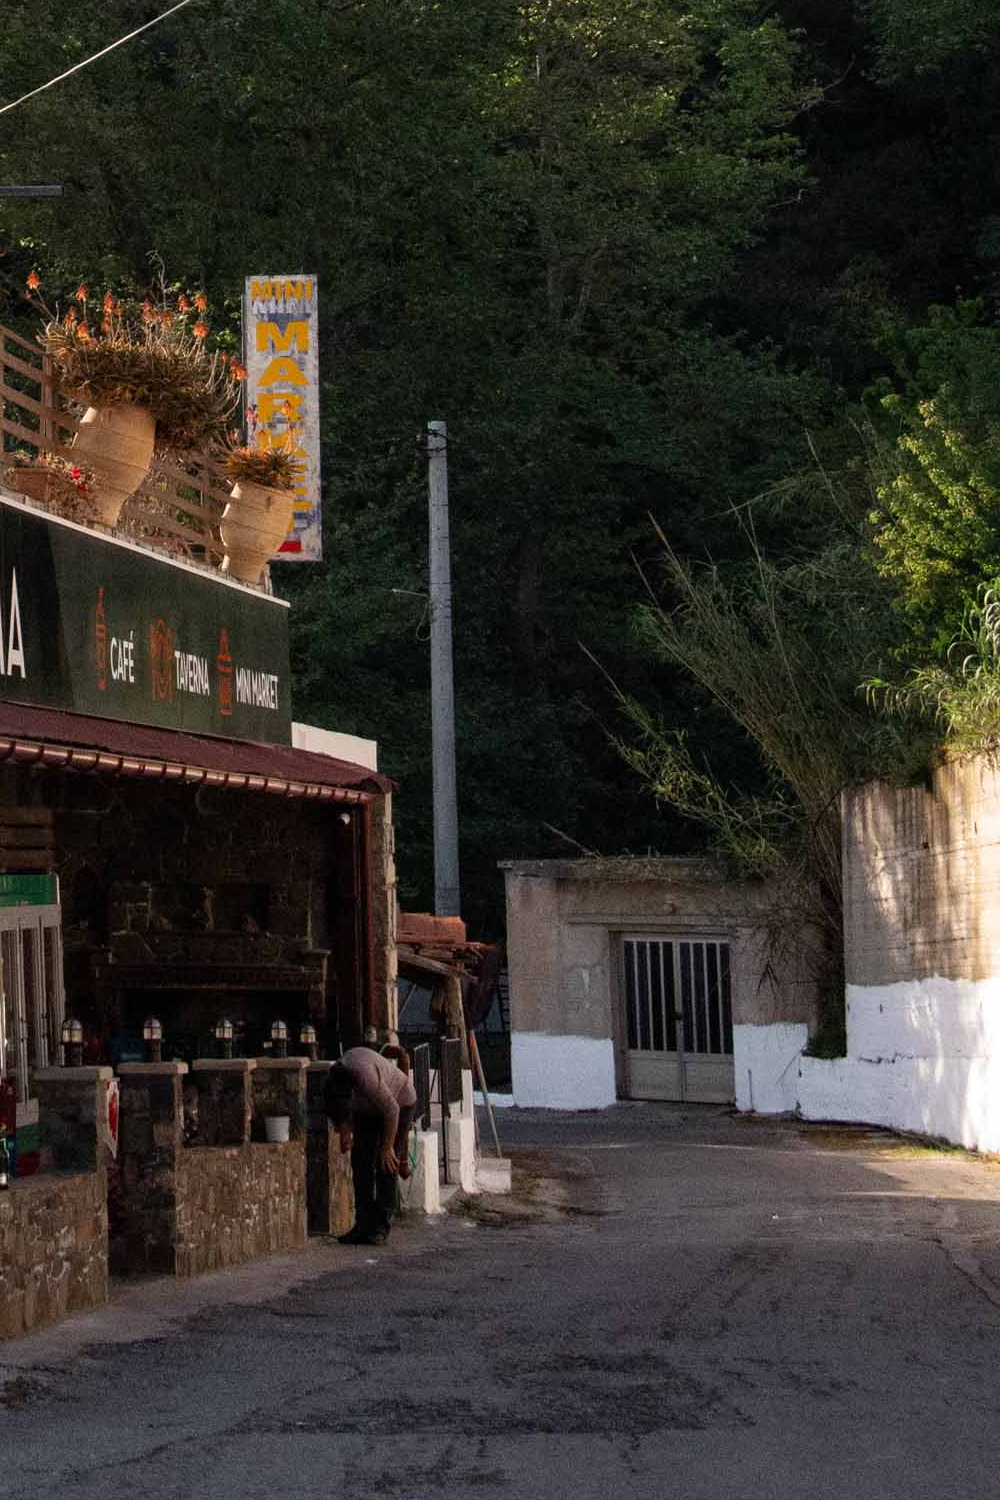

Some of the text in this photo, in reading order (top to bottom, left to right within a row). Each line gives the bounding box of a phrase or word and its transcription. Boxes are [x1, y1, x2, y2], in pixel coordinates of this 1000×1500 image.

[250, 280, 313, 300] MINI
[110, 630, 135, 683] CAFÉ
[174, 650, 210, 697] TAVERNA
[235, 667, 279, 710] MINI MARKET
